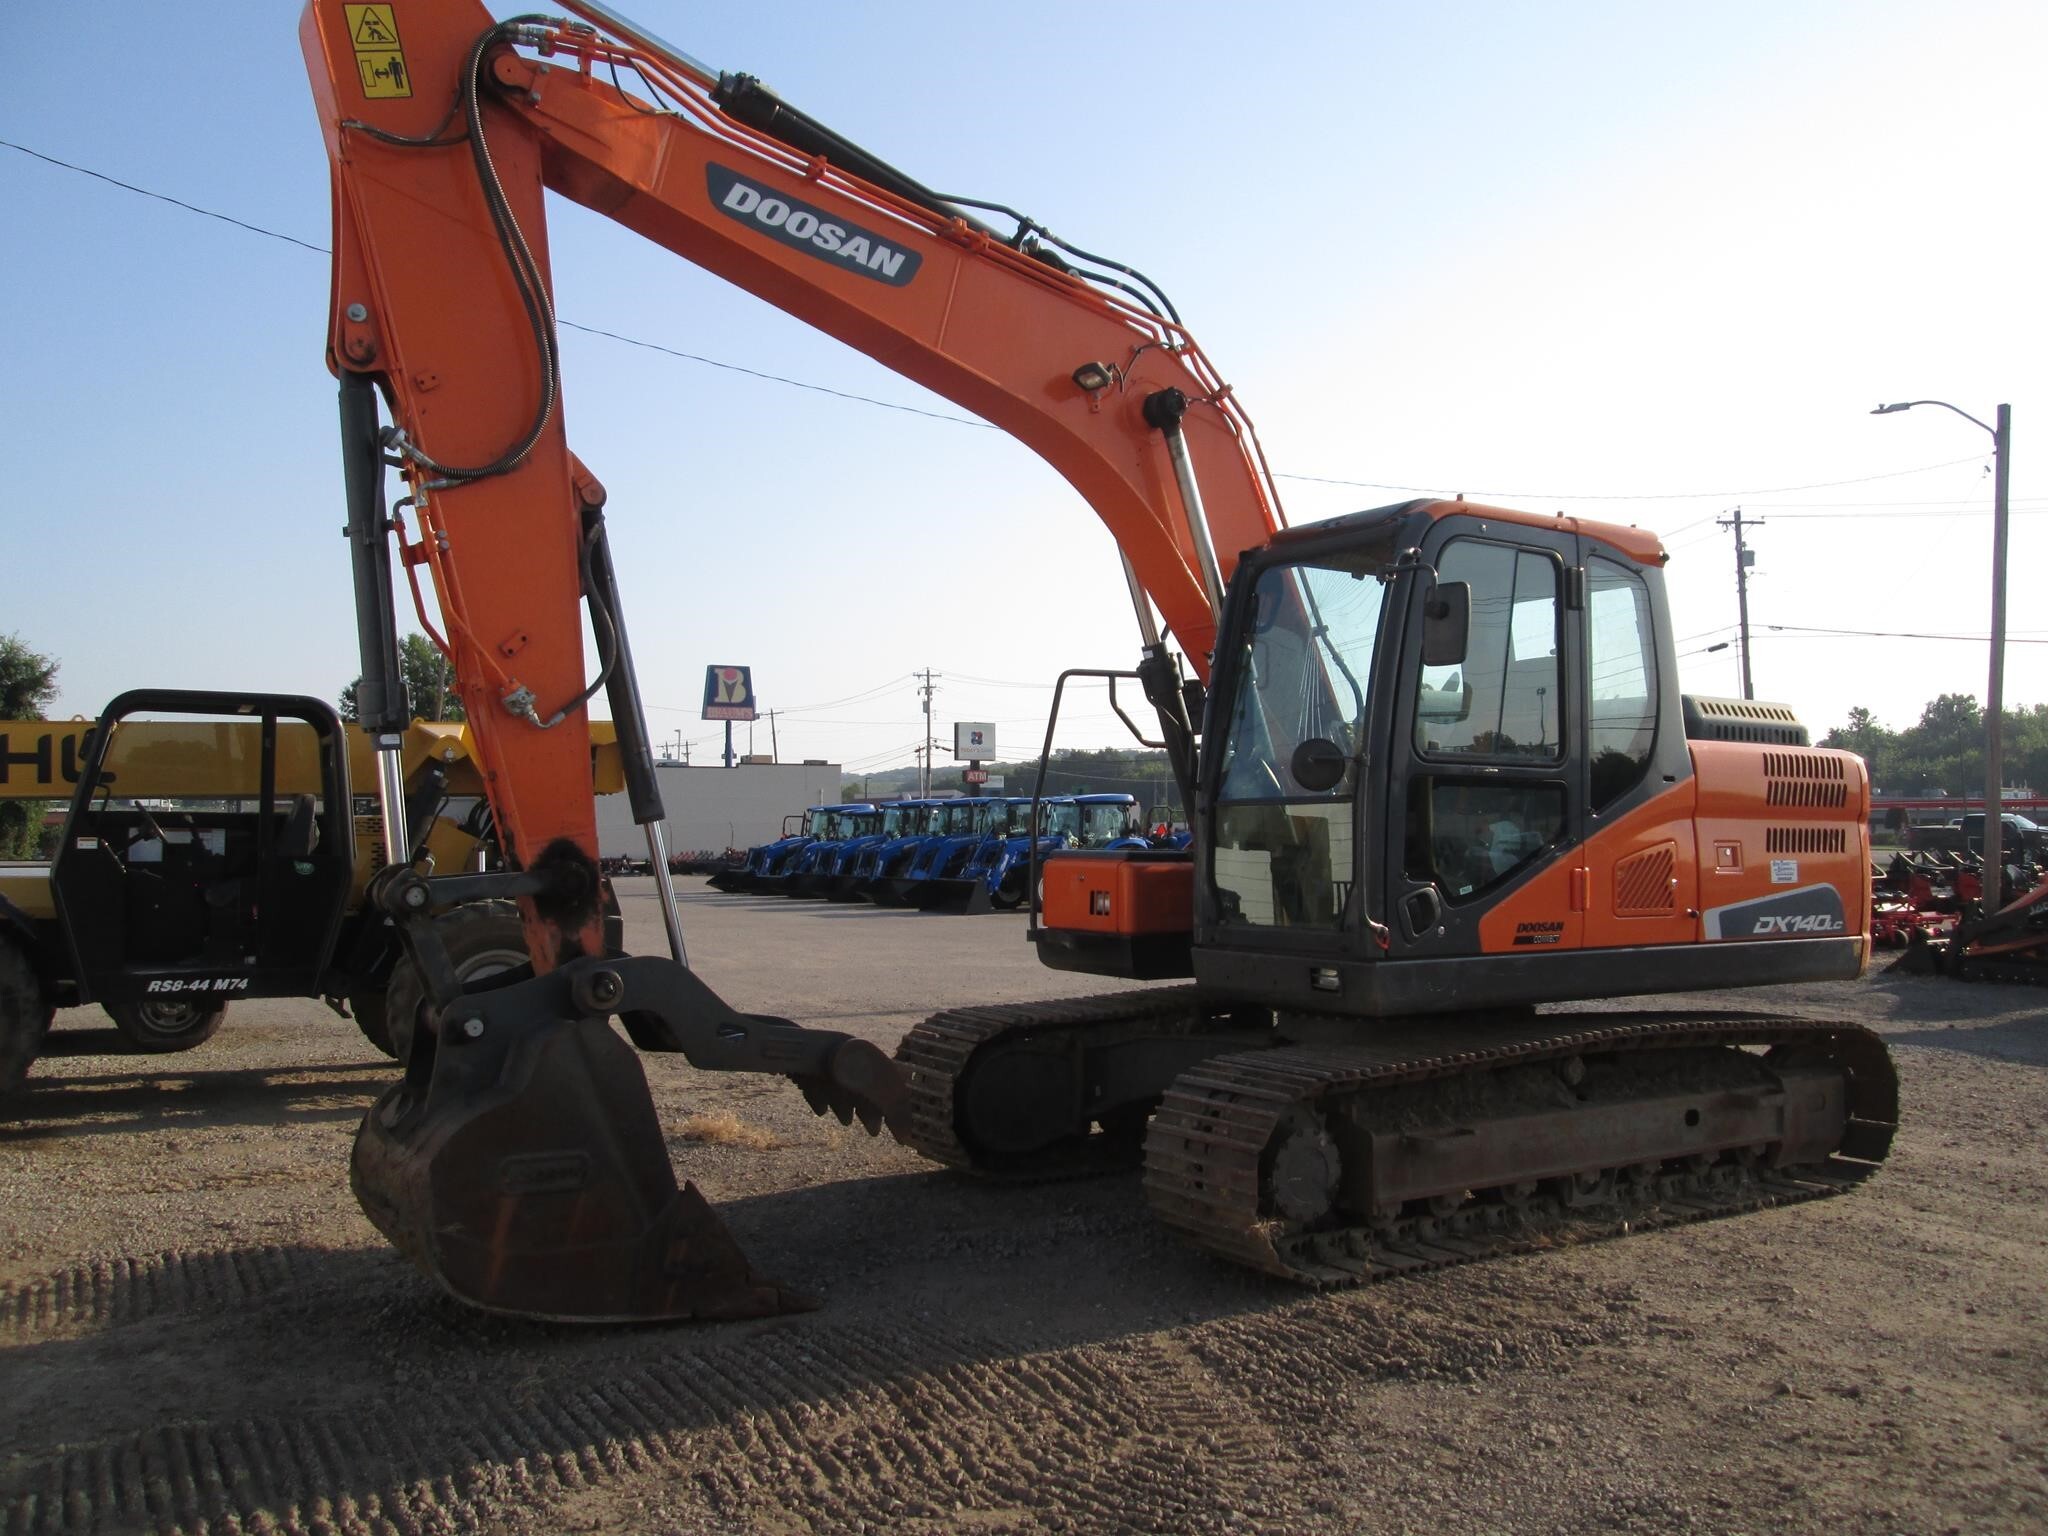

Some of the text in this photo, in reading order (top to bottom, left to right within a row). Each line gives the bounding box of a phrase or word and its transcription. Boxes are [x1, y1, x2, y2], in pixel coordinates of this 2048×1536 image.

[722, 182, 906, 278] DOOSAN
[967, 771, 987, 782] ATM
[147, 978, 249, 992] RS8-44 M74
